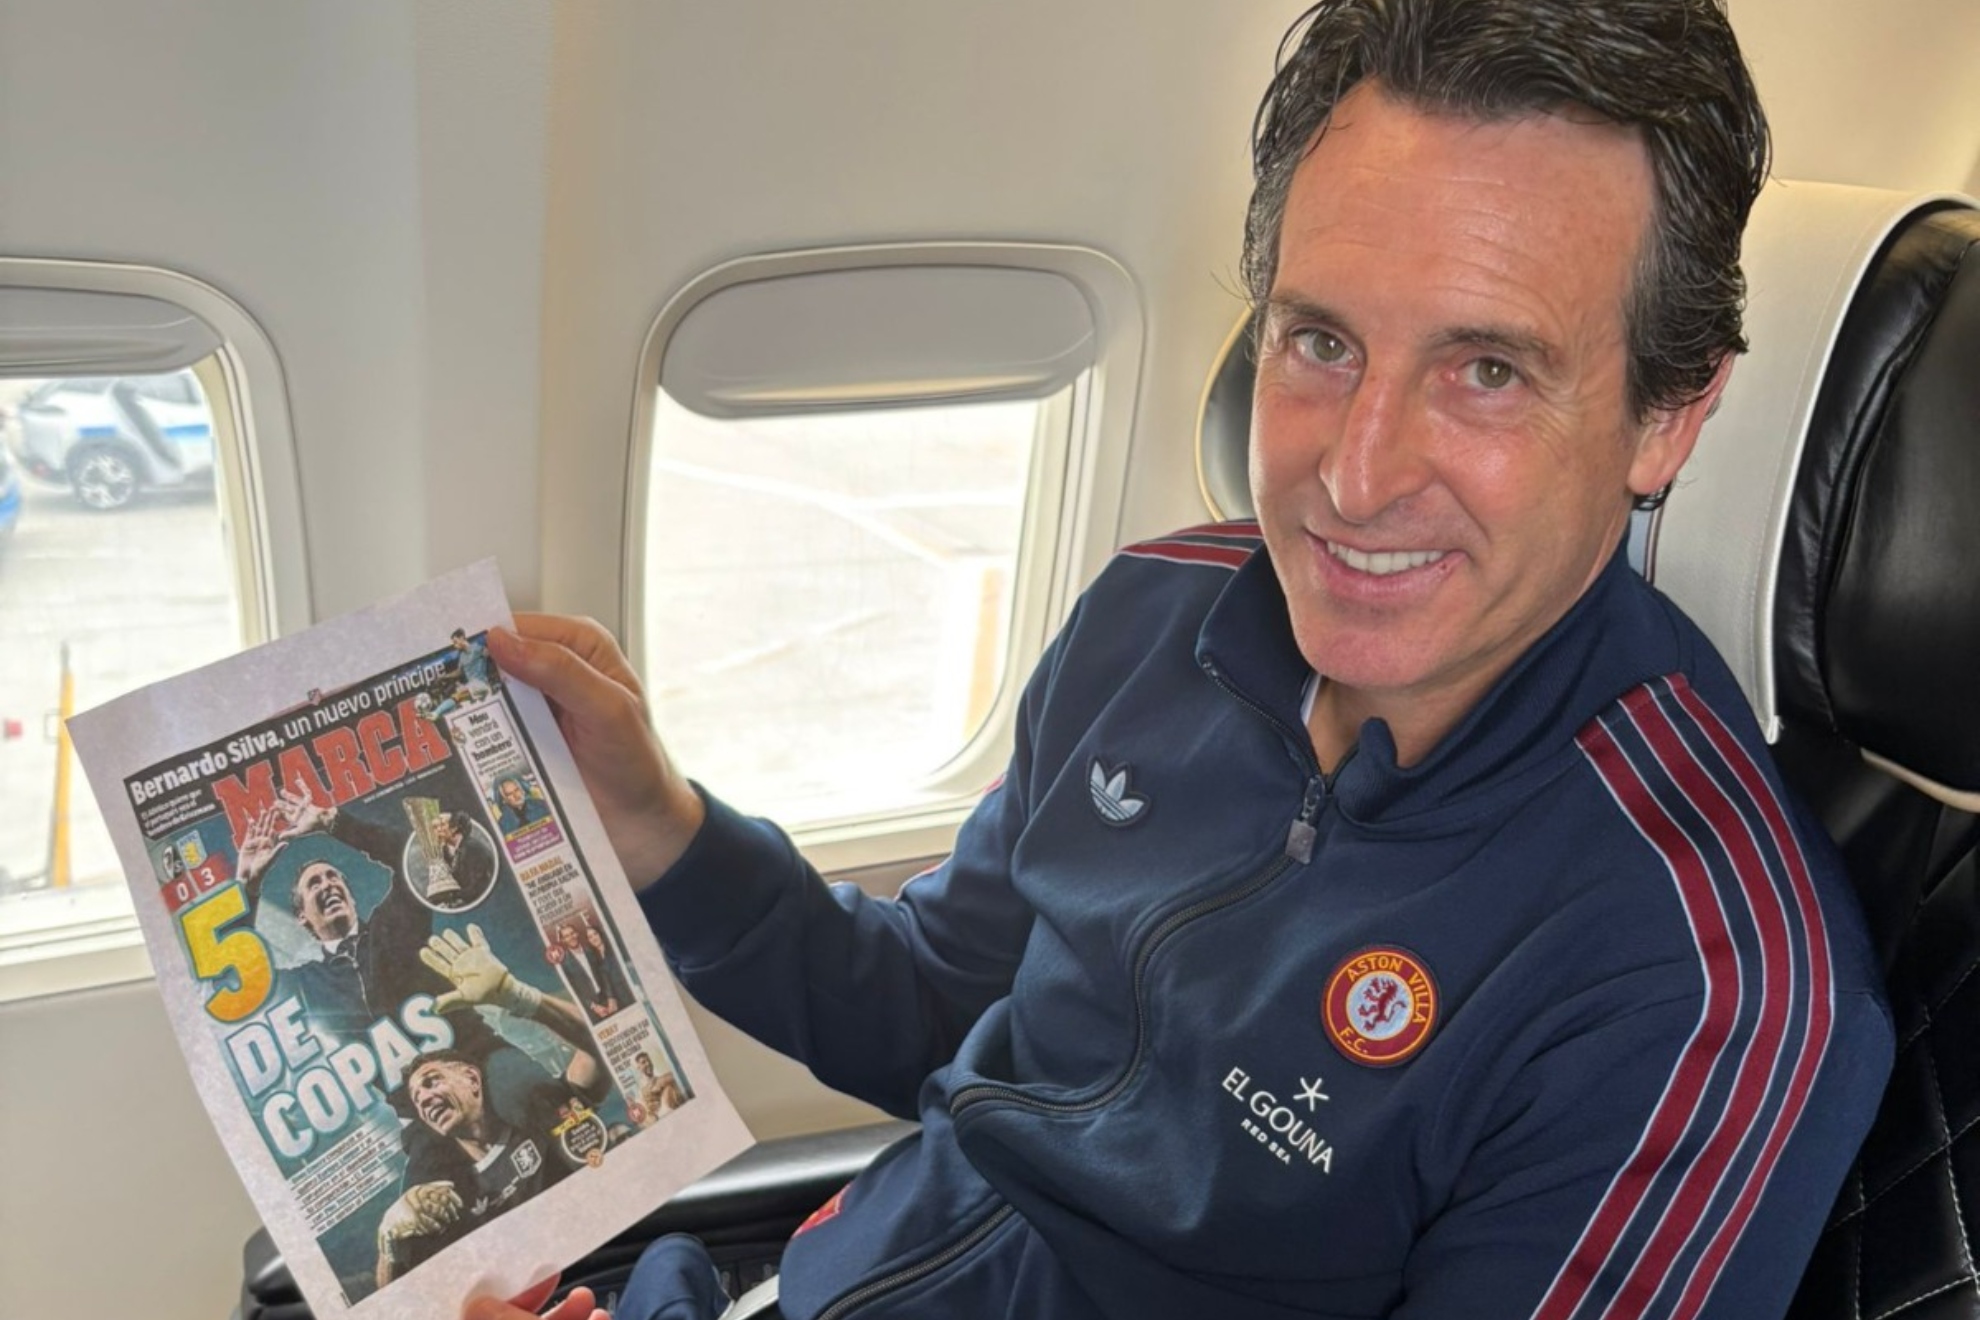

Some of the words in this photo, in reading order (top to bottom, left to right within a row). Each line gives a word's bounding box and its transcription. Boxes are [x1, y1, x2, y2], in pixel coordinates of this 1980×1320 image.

[130, 751, 229, 805] Bernardo
[225, 727, 283, 763] Silva,
[283, 717, 311, 739] un
[313, 693, 371, 726] nuevo
[372, 660, 445, 705] príncipe
[468, 712, 488, 724] Mou
[469, 719, 498, 737] vendrá
[474, 736, 490, 748] con
[490, 730, 503, 742] un
[211, 692, 451, 851] MARCA
[176, 882, 190, 901] 0
[201, 867, 216, 886] 3
[181, 885, 272, 1022] 5
[1347, 956, 1403, 982] ASTON
[1408, 972, 1430, 1023] VILLA
[227, 996, 322, 1096] DE
[1340, 1026, 1369, 1055] F.C.
[263, 994, 454, 1157] COPAS
[1222, 1066, 1251, 1102] EL
[1250, 1090, 1333, 1174] GOUNA
[1240, 1118, 1268, 1143] RED
[1268, 1141, 1292, 1165] SEA
